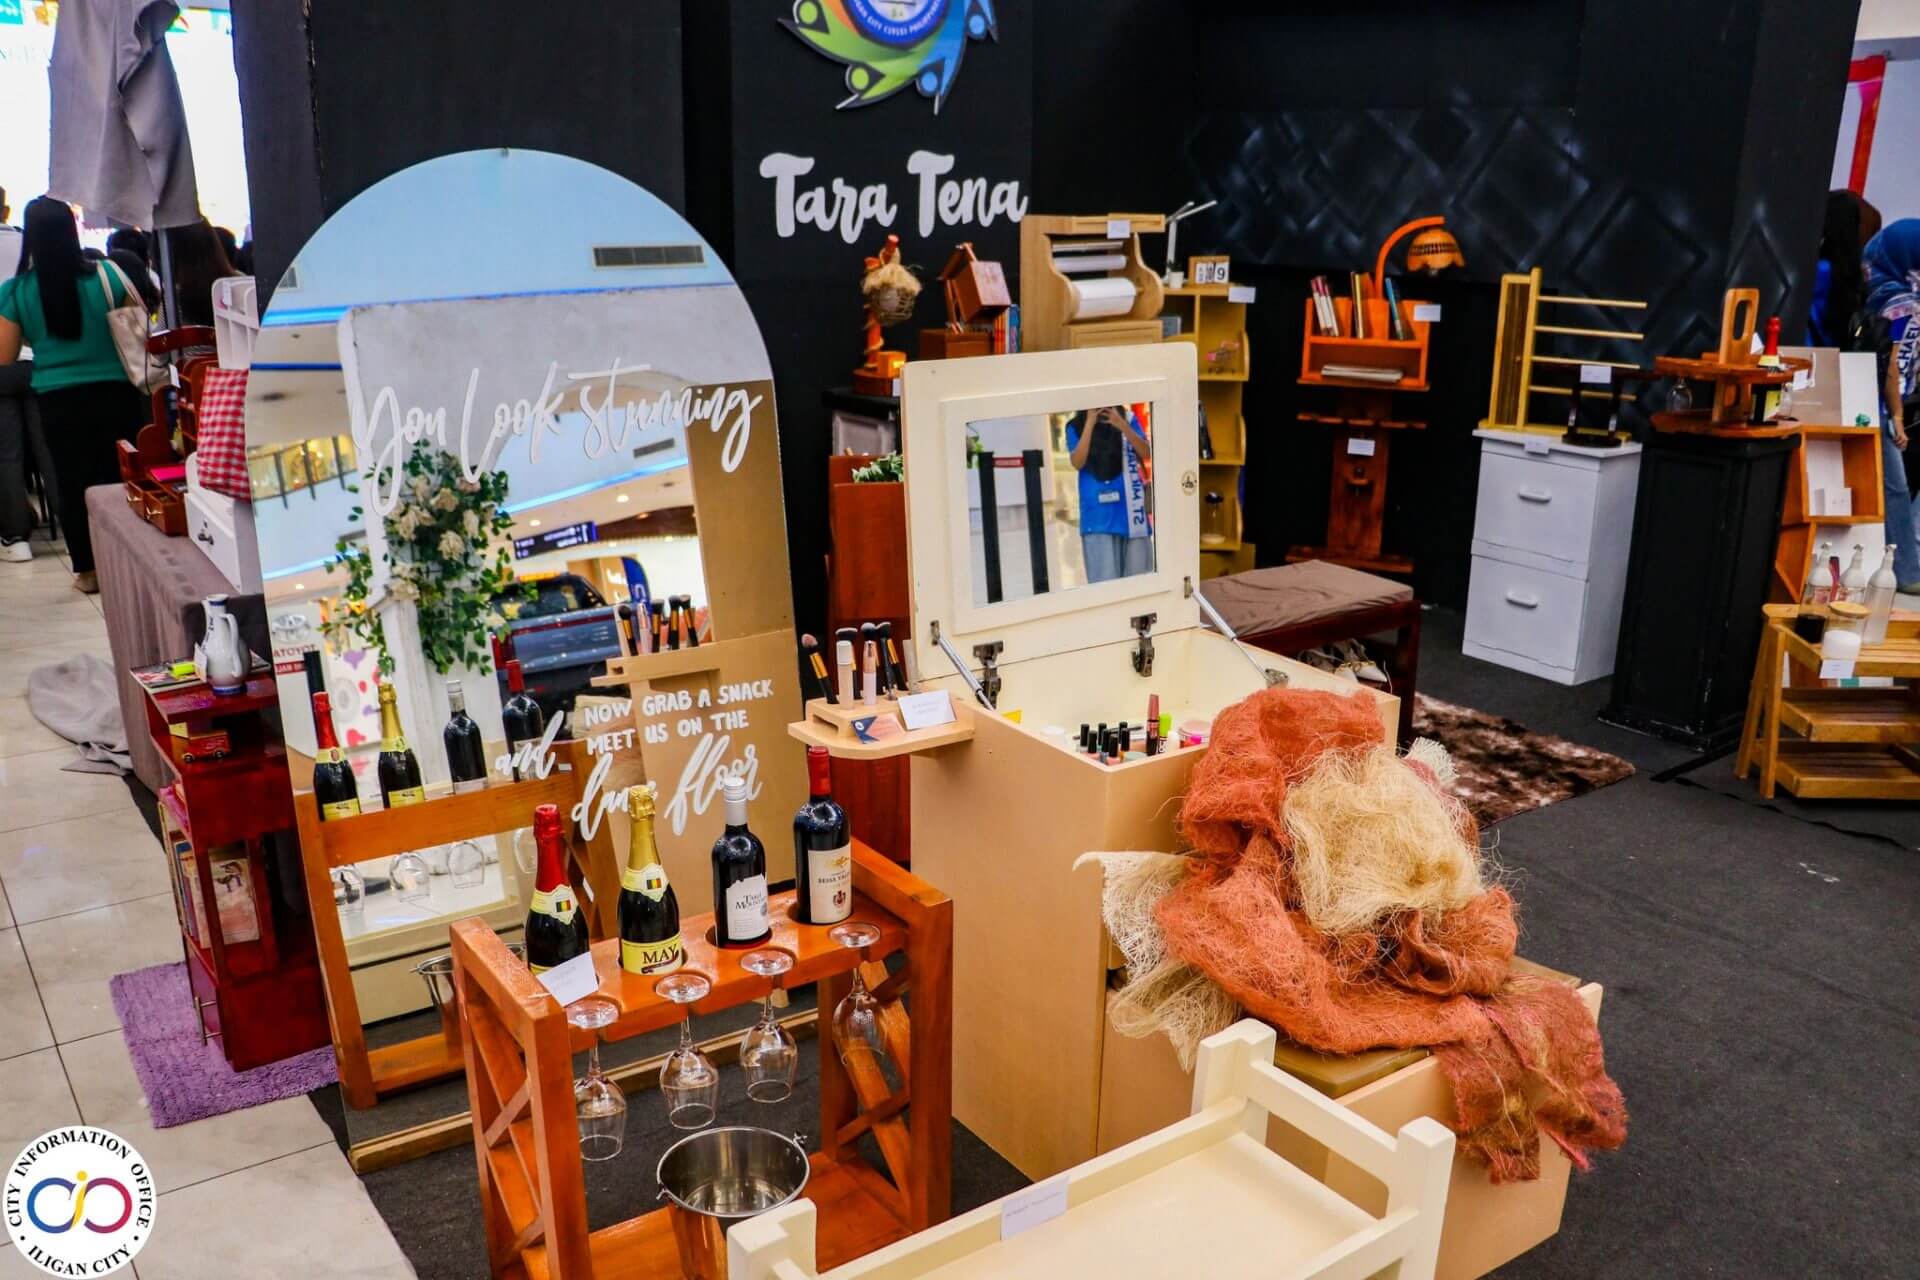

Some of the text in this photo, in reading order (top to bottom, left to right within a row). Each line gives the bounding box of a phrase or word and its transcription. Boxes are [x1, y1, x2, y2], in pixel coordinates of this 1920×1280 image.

[759, 150, 1028, 244] Tara Tena
[352, 386, 446, 516] You
[460, 361, 564, 483] Look
[583, 679, 774, 727] NOW GRAB A SNACK
[587, 710, 749, 756] MEET US ON THE
[642, 944, 677, 964] MAY
